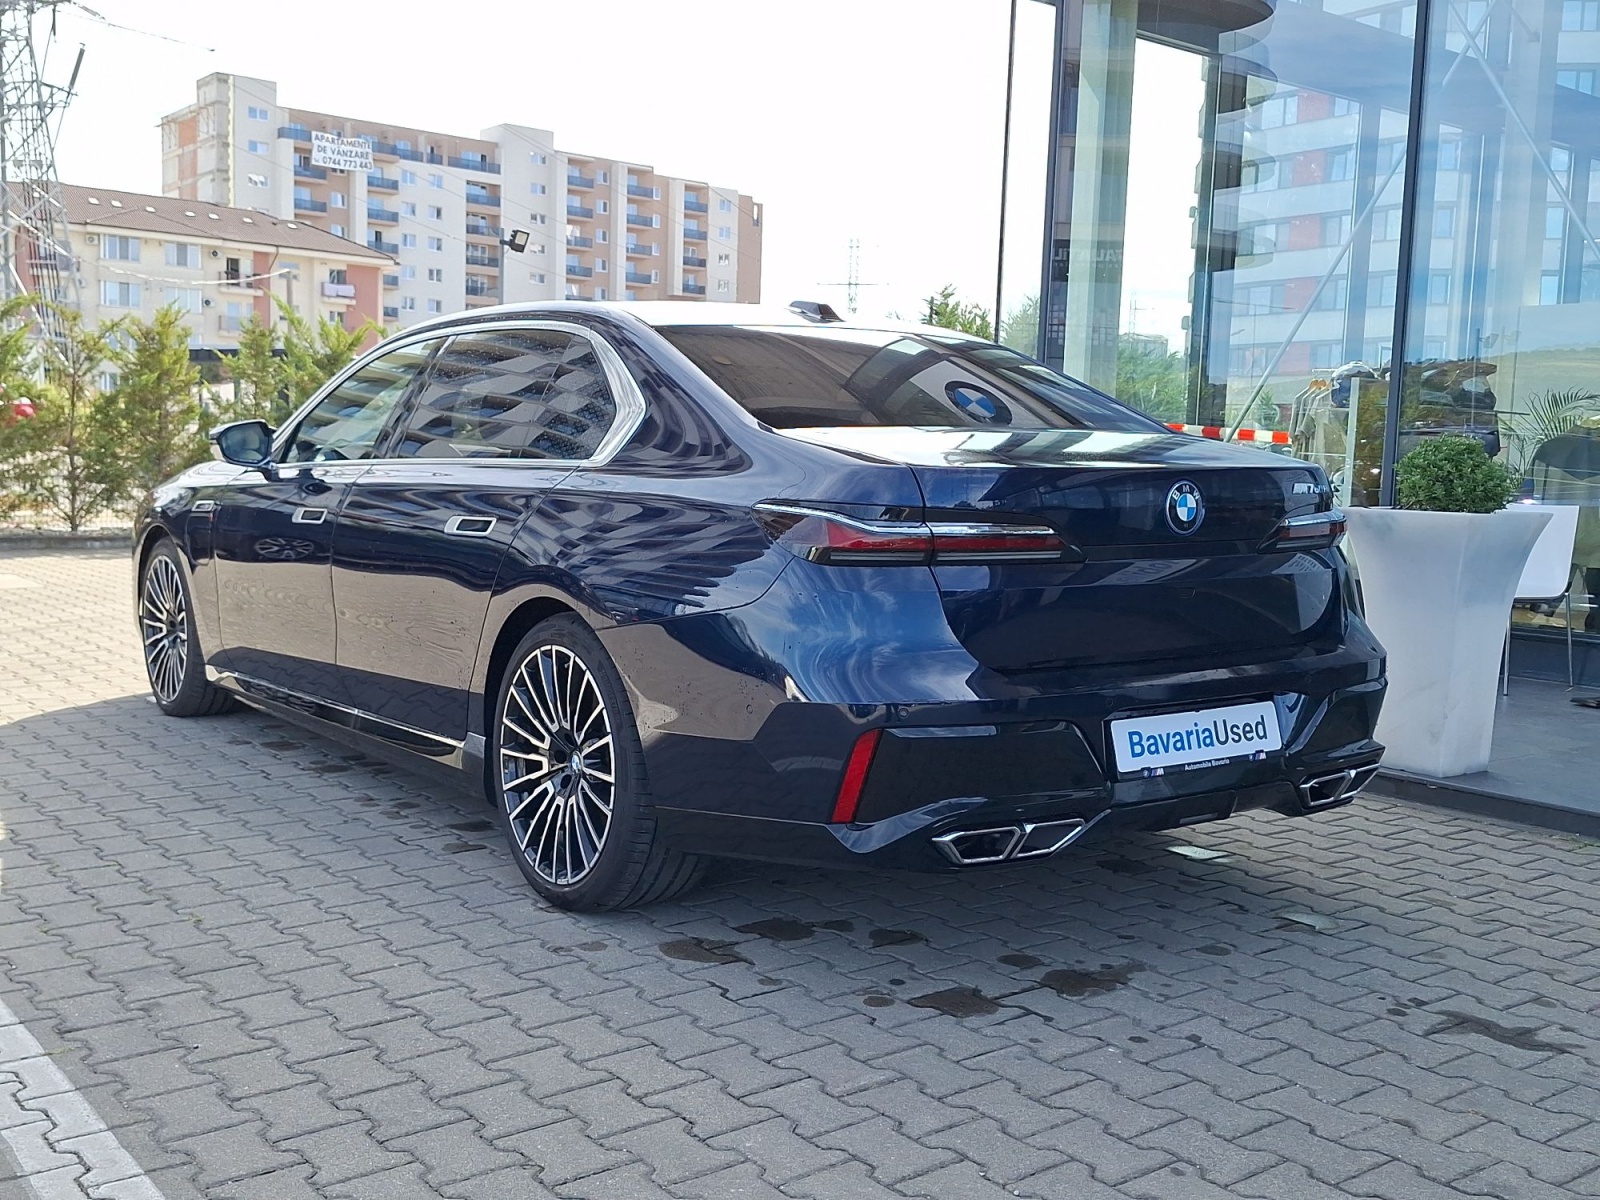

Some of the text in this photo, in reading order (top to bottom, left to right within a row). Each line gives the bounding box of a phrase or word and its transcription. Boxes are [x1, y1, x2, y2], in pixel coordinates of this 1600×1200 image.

[317, 145, 328, 154] DE
[322, 156, 341, 166] 0744
[342, 160, 357, 168] 773
[359, 162, 373, 170] 443
[1172, 484, 1200, 500] BMW
[1127, 714, 1268, 758] BavariaUsed
[1211, 758, 1230, 767] Bavaria
